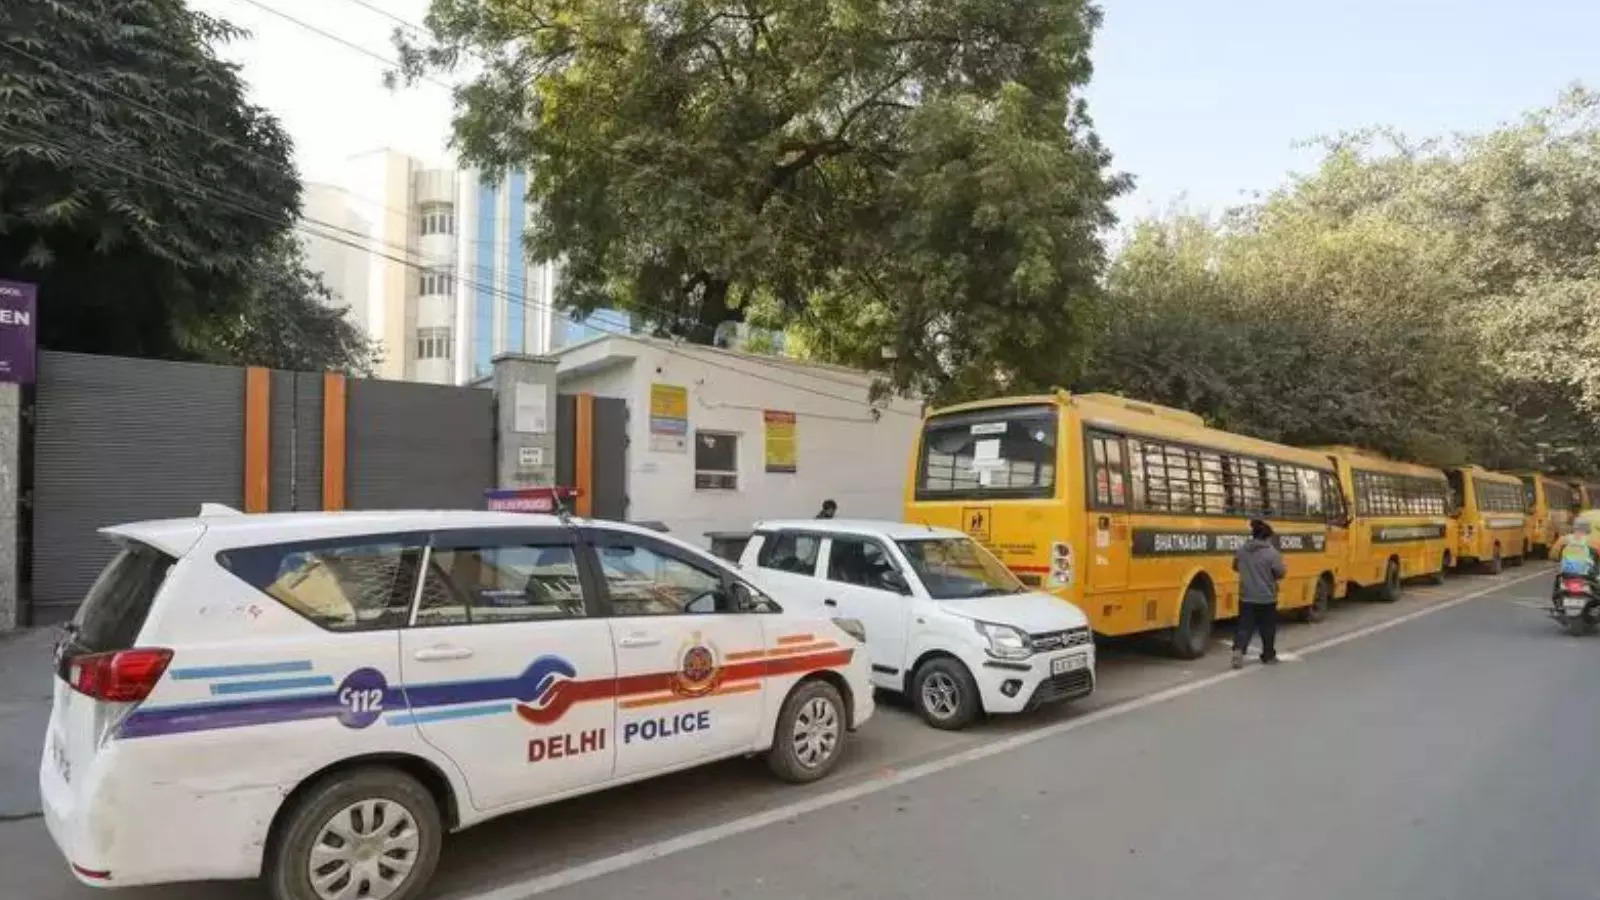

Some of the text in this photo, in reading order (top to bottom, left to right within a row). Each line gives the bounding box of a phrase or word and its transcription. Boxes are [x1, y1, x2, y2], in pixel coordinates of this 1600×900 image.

[1154, 533, 1207, 551] BHATNAGAR
[1280, 535, 1303, 549] SCHOOL
[528, 710, 710, 763] DELHI POLICE
